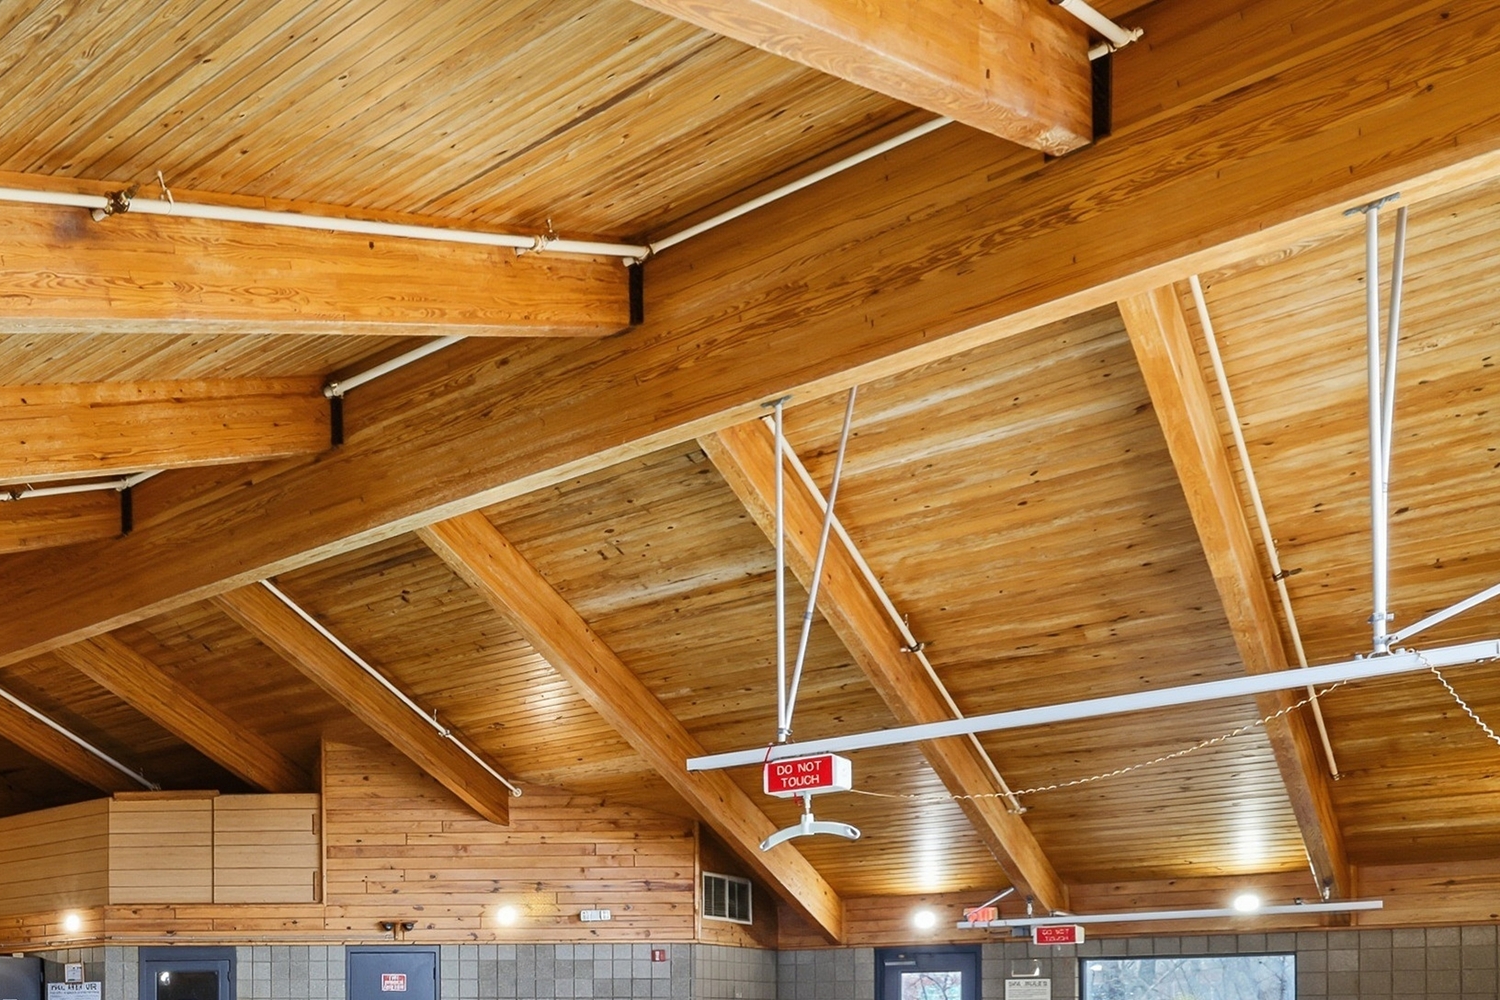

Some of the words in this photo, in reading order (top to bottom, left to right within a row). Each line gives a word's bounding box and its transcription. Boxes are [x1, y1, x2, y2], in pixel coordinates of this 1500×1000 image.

[776, 764, 793, 776] DO
[797, 760, 822, 773] NOT
[781, 774, 820, 788] TOUCH
